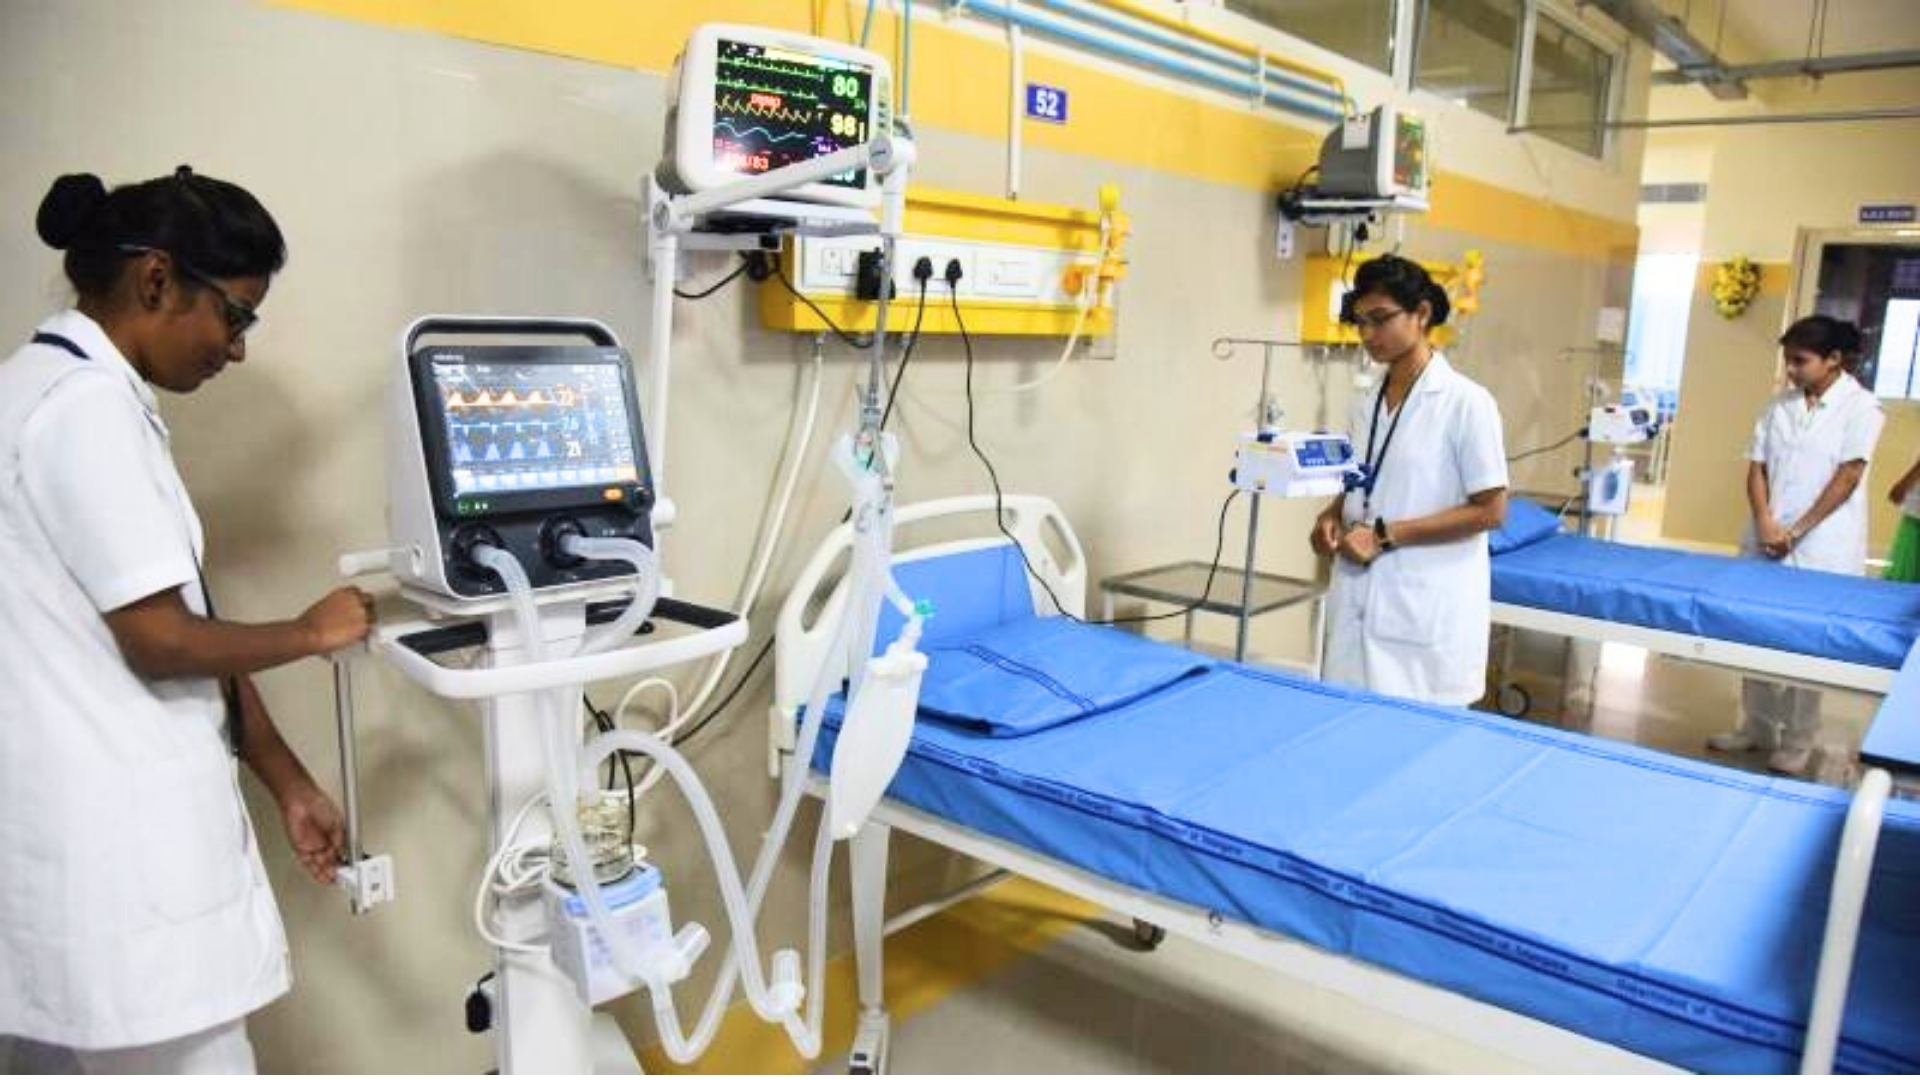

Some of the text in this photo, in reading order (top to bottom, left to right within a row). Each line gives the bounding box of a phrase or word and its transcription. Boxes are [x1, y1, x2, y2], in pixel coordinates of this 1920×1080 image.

[833, 75, 858, 98] 80
[1036, 88, 1059, 116] 52
[830, 113, 857, 136] 98
